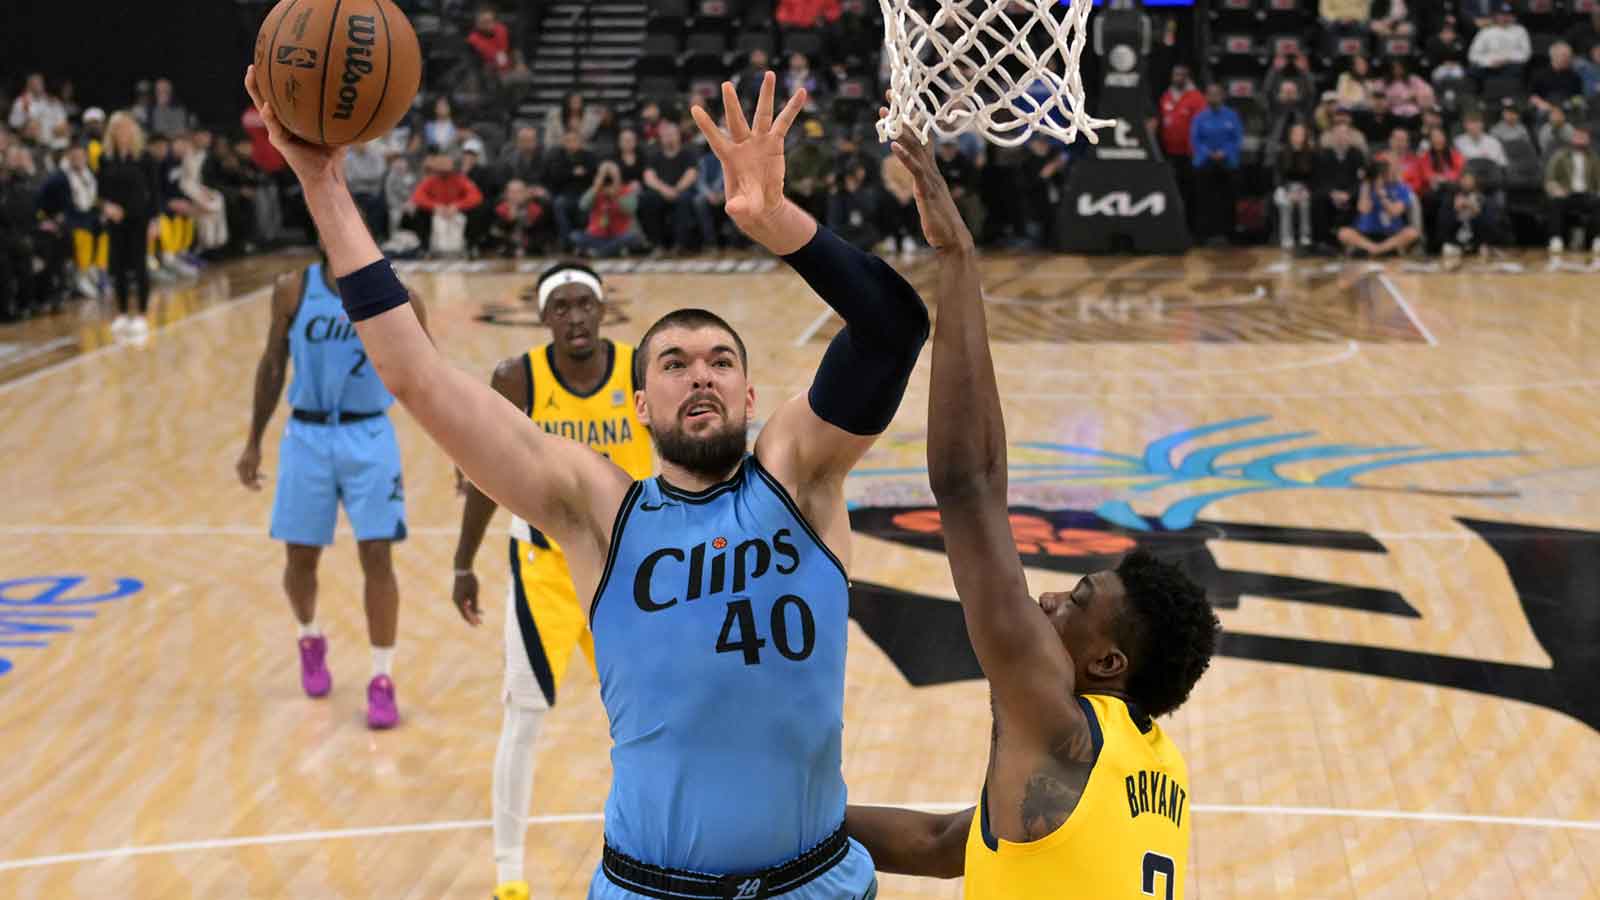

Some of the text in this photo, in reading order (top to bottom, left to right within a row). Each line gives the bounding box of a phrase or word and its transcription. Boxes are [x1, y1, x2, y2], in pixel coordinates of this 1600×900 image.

[332, 15, 376, 120] Wilson
[304, 315, 357, 343] Clip
[350, 348, 367, 377] 2
[537, 417, 633, 446] NDIANA
[633, 528, 800, 612] Clips
[715, 594, 816, 666] 40
[1125, 770, 1186, 829] BRYANT
